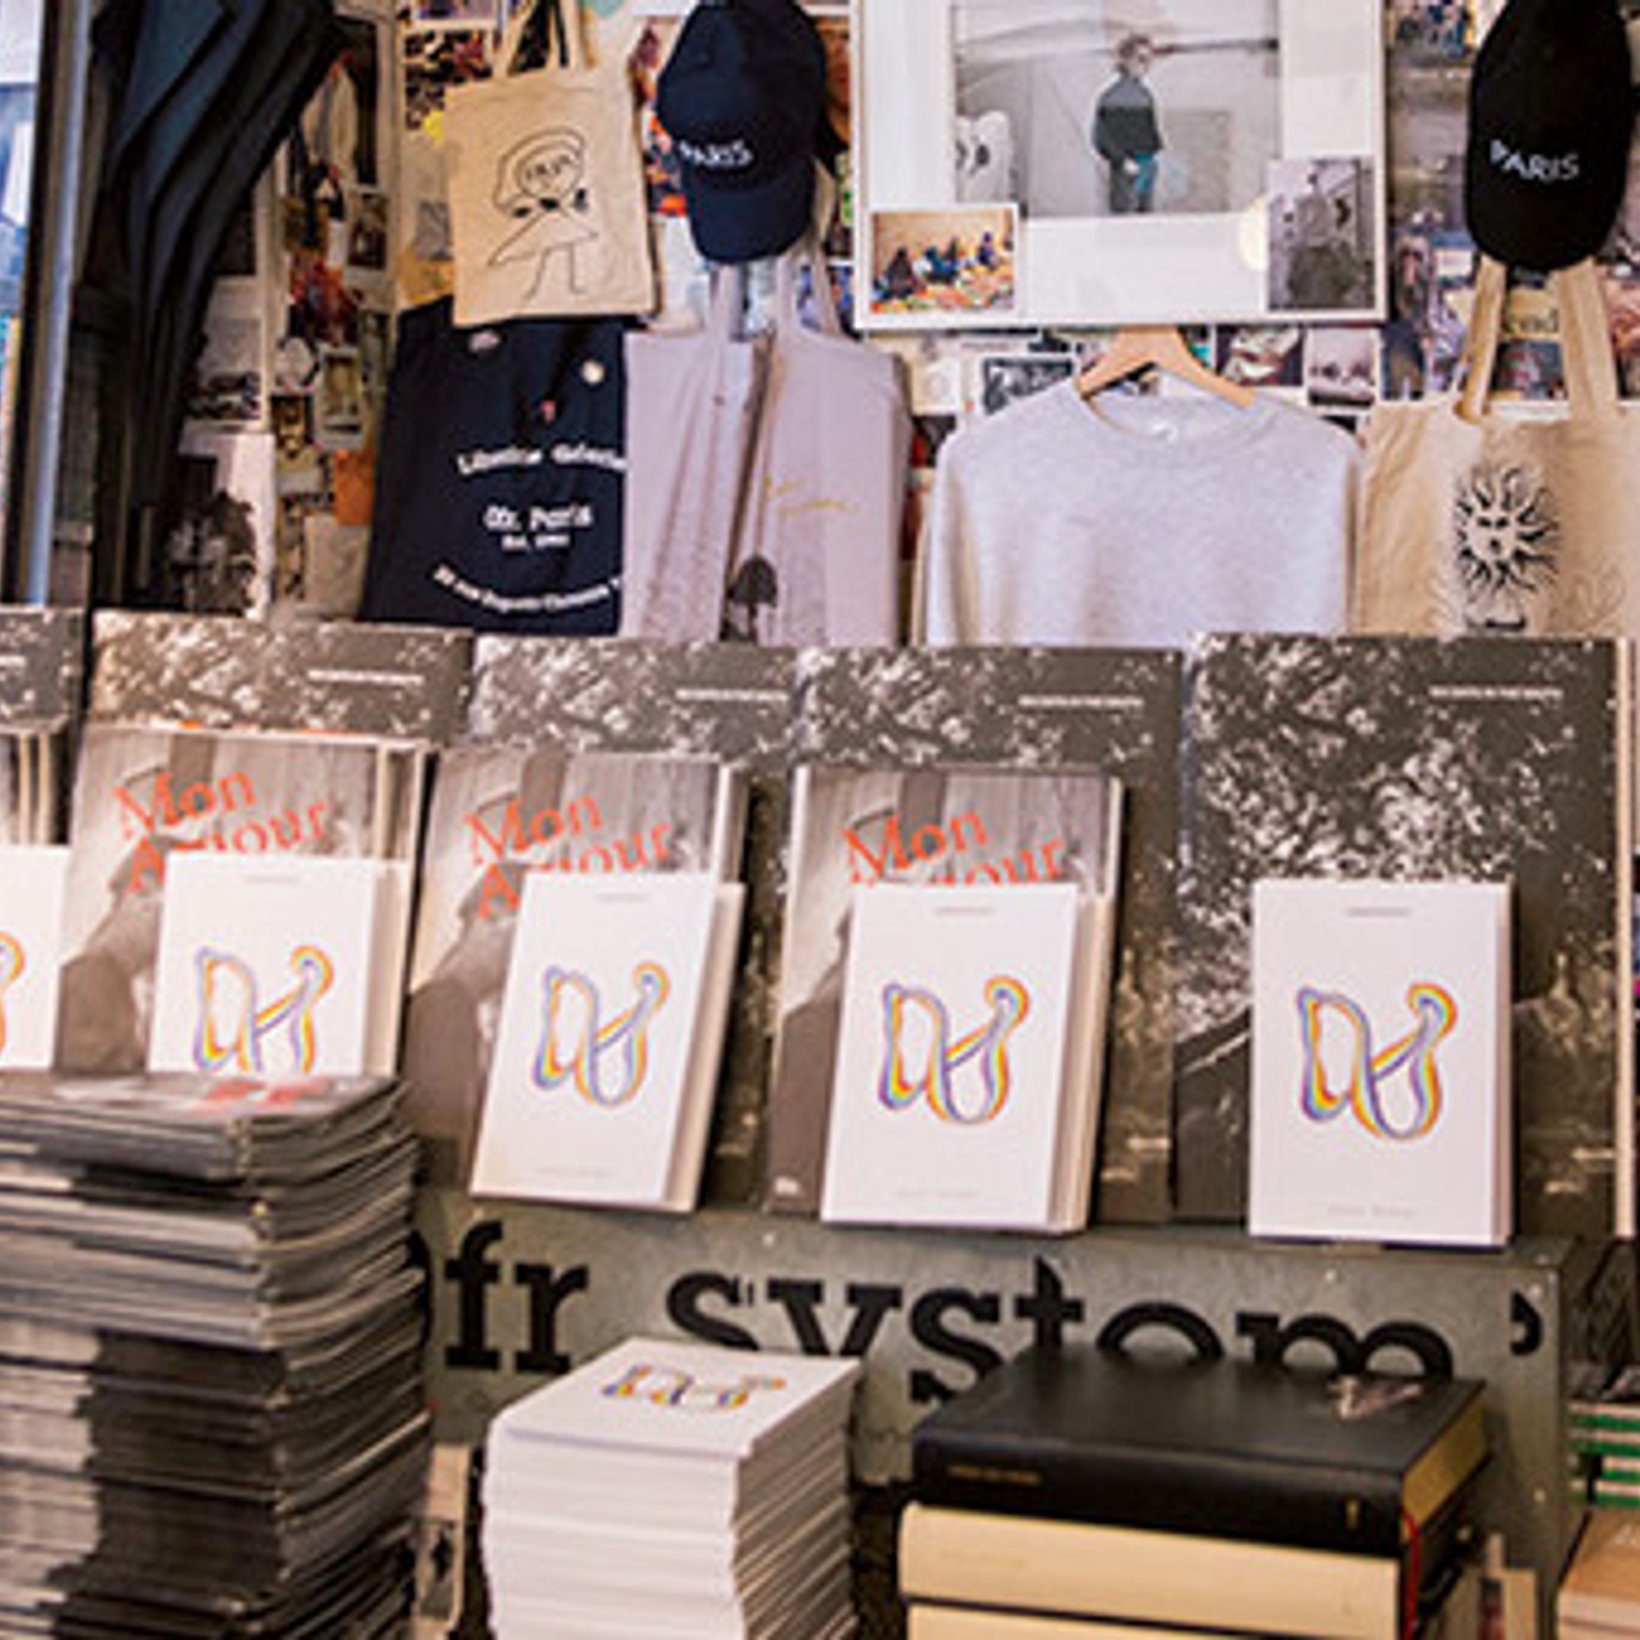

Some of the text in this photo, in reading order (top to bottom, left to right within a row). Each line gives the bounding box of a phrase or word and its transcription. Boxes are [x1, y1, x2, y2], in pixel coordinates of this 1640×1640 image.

[1489, 138, 1580, 184] PARIS
[112, 769, 257, 840] Mon
[463, 794, 604, 868] Mon
[477, 820, 673, 919] Aour
[841, 811, 987, 884] Mon
